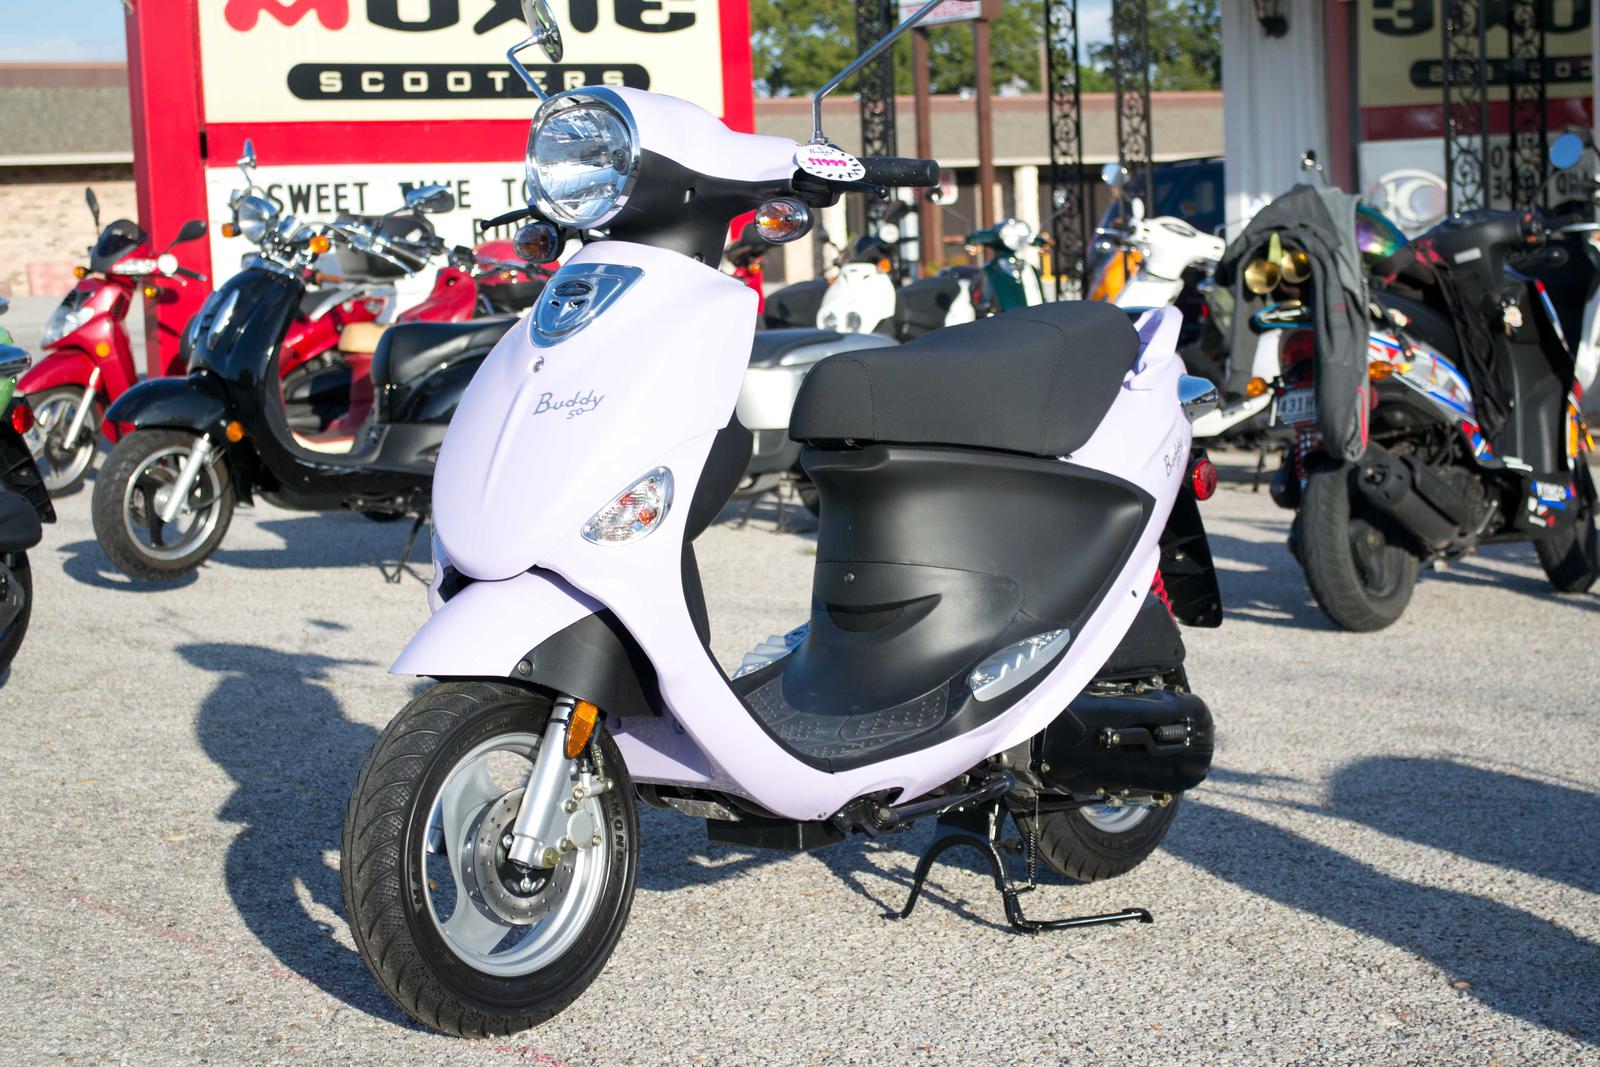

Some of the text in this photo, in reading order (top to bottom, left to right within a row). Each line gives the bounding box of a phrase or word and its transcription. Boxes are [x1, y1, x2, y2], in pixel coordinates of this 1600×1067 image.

[319, 70, 623, 93] SCOOTERS
[267, 178, 528, 214] SWEET TE T
[532, 389, 606, 416] Buddy
[566, 407, 584, 420] 50
